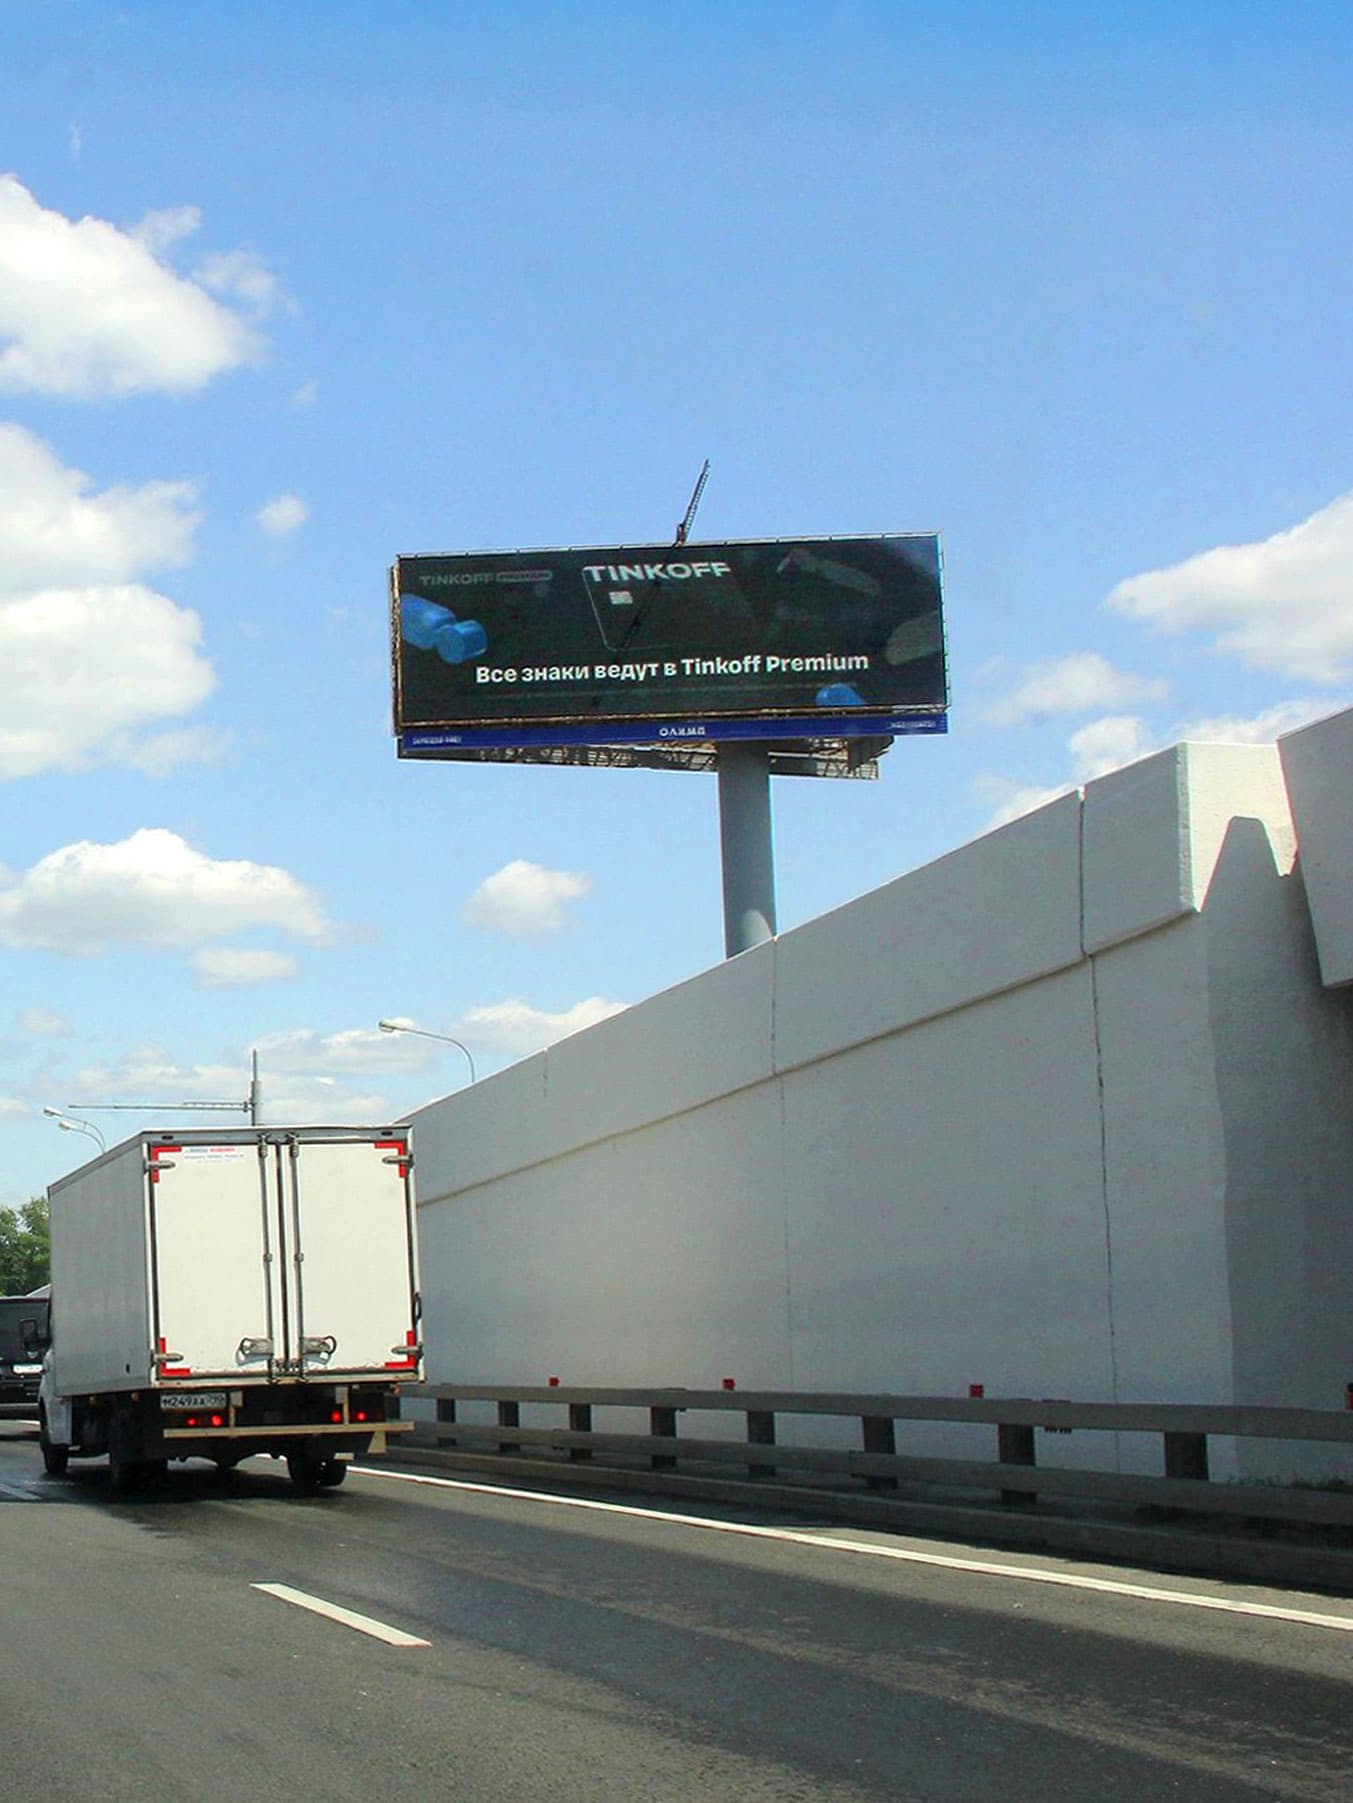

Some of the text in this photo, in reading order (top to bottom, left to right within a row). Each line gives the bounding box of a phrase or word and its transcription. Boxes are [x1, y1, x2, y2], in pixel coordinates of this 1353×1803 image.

[419, 572, 494, 586] TINKOFF
[585, 562, 731, 583] TINKOFF
[476, 653, 869, 683] Все знаки ведут в Tinkoff Premium
